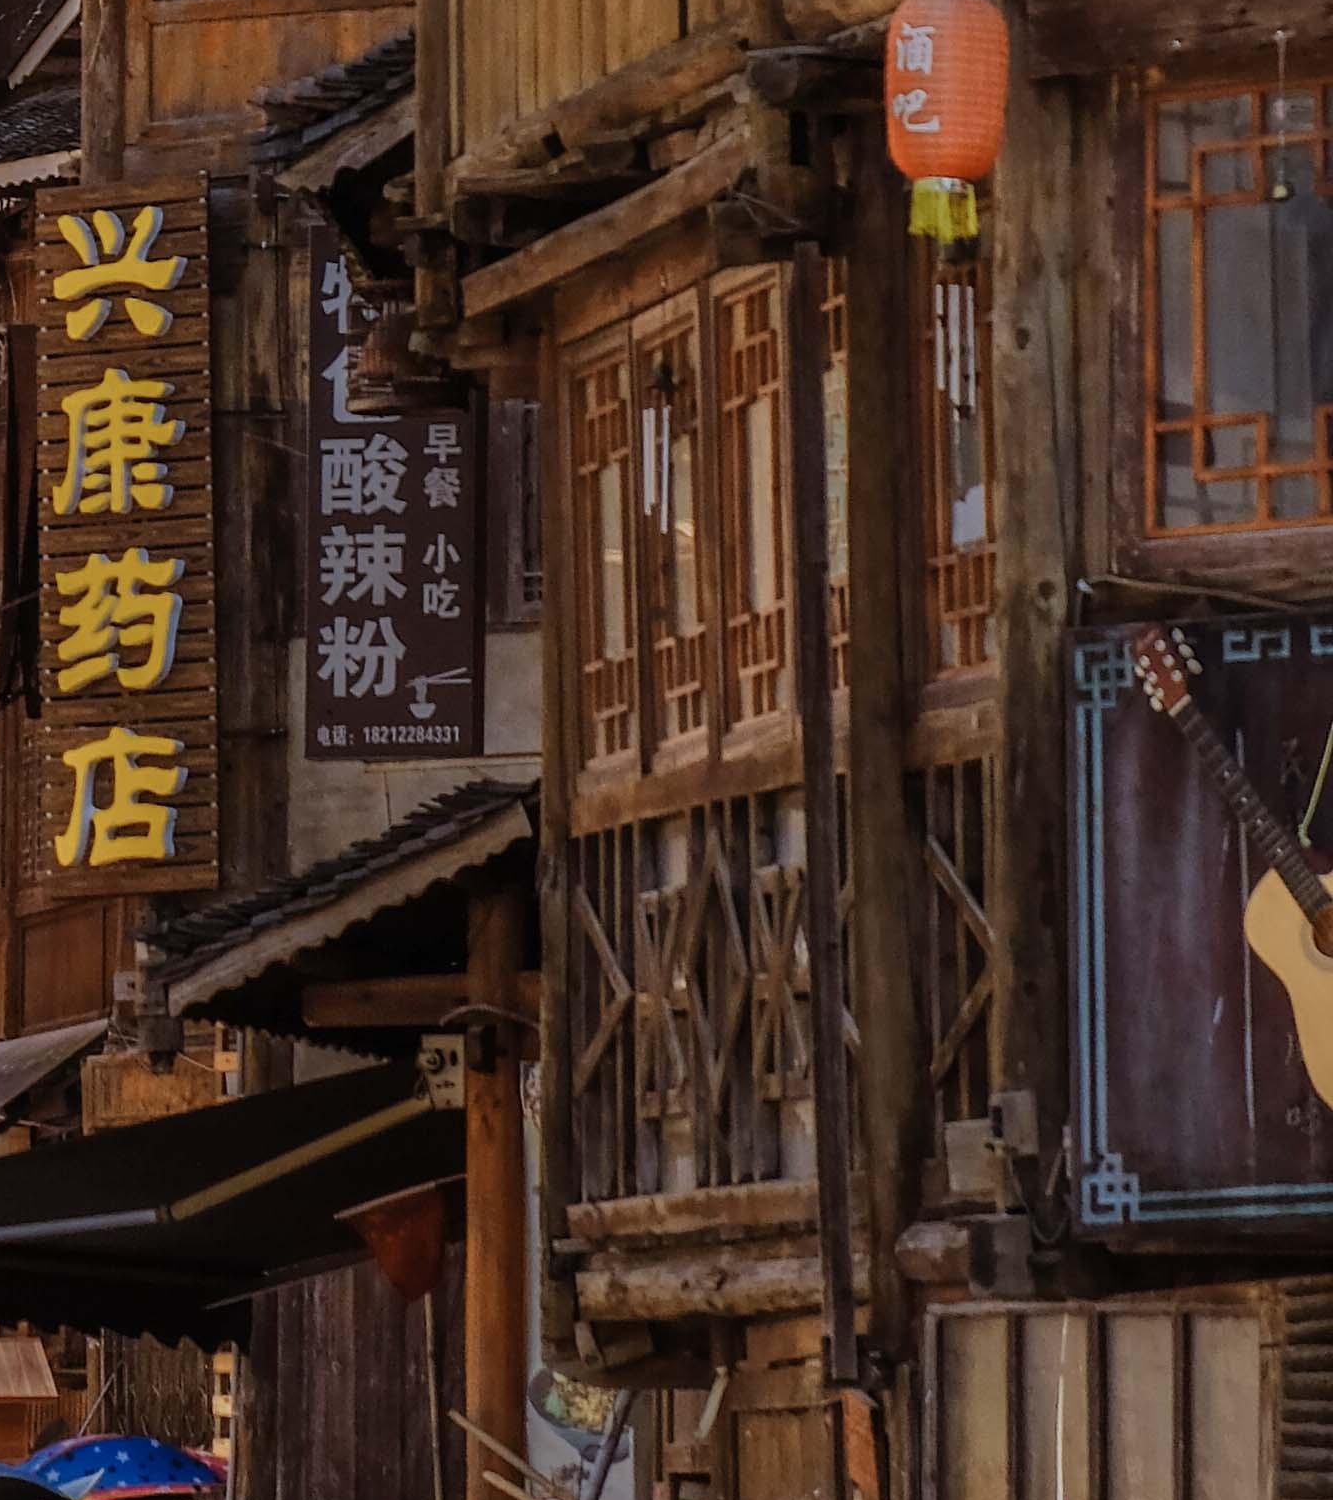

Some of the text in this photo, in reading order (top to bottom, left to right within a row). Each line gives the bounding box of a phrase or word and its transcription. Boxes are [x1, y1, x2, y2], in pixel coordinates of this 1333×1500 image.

[53, 205, 188, 868] 兴康药店
[422, 424, 462, 620] 早餐 小吃
[362, 727, 461, 744] 18212284331
